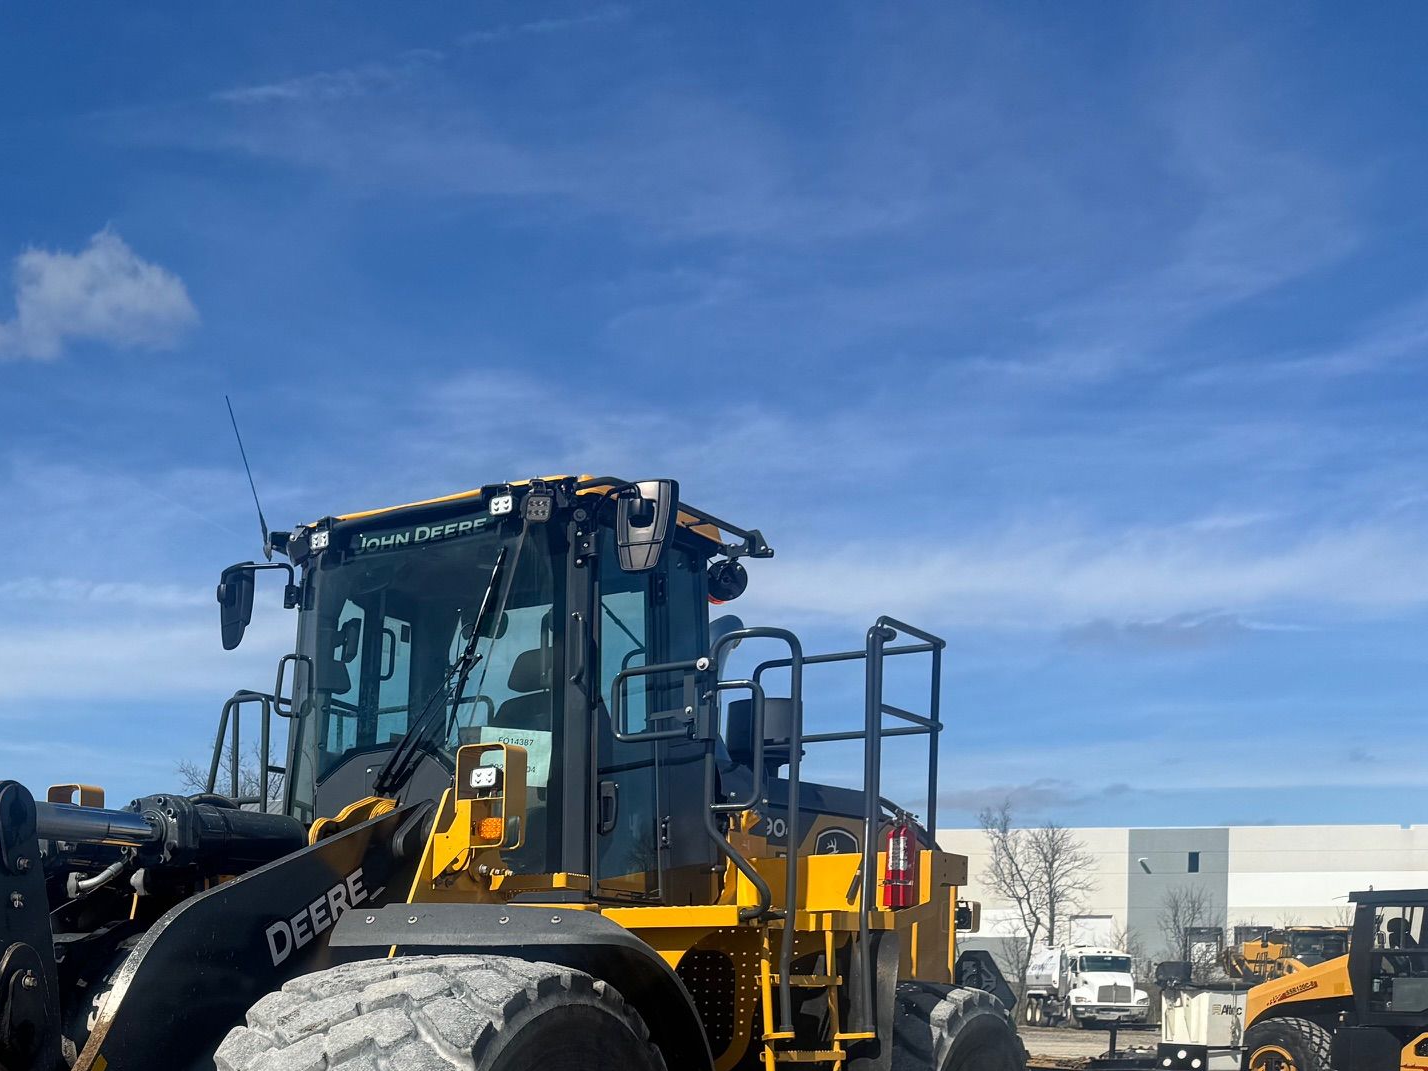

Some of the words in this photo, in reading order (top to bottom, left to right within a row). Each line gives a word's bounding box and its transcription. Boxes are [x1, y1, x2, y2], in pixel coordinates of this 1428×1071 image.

[355, 532, 410, 555] JOHN
[414, 518, 487, 543] DEERE
[265, 867, 368, 967] DEERE
